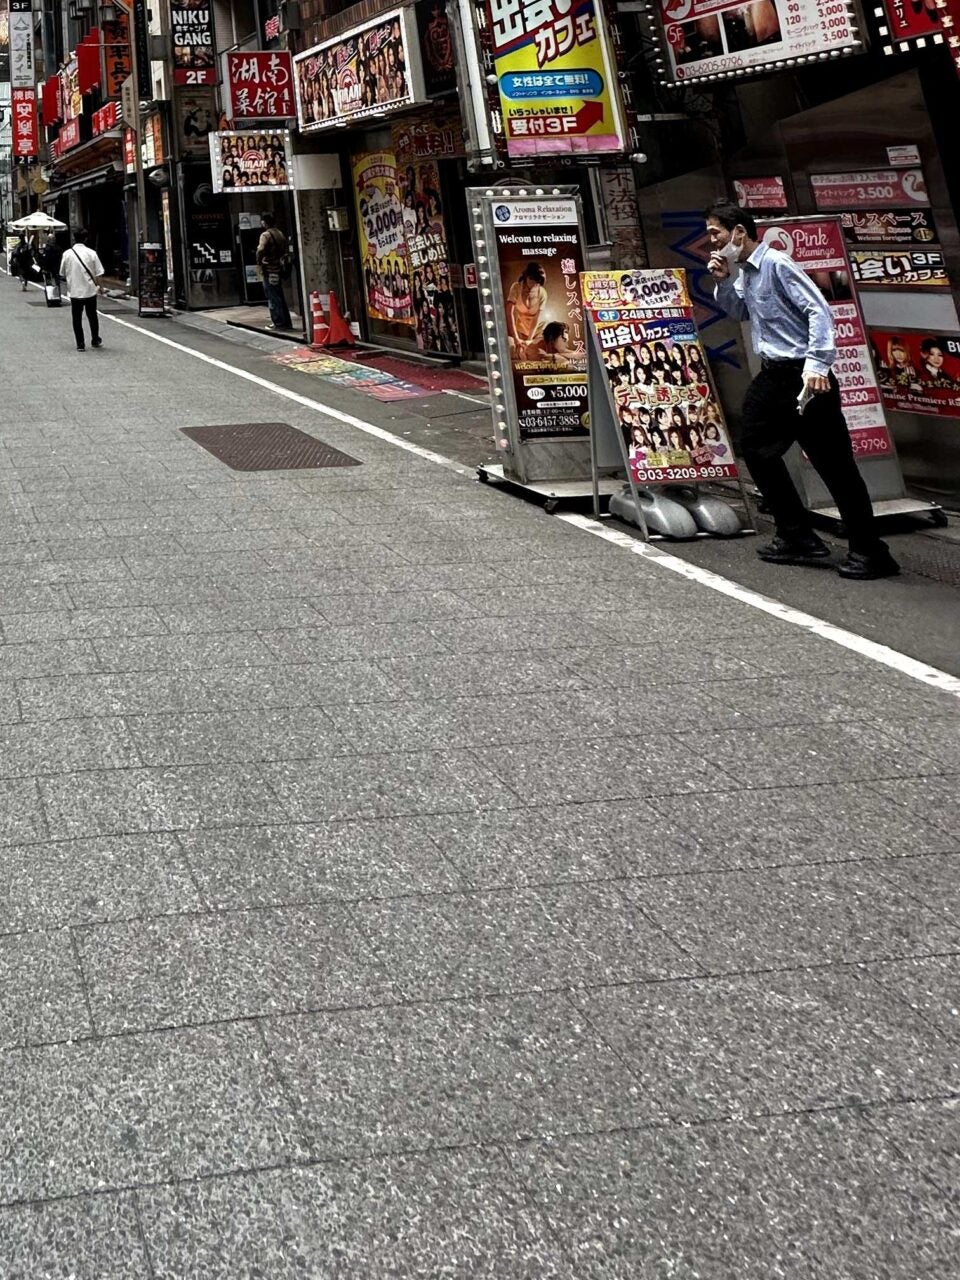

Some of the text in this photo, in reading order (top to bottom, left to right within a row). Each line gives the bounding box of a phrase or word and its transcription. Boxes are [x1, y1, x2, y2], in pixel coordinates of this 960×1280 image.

[12, 2, 29, 10] 3F
[818, 4, 844, 19] 3,000
[172, 10, 210, 26] NIKU
[820, 17, 847, 31] 3,000
[173, 32, 212, 47] GANG
[534, 11, 596, 69] カフェ
[668, 26, 683, 43] 5F
[823, 29, 850, 43] 3,500
[231, 54, 289, 86] 湖南
[185, 70, 207, 85] 2F
[13, 90, 35, 101] 焼肉
[234, 87, 278, 117] 菜館
[511, 116, 578, 135] 受付3F
[19, 156, 34, 165] 2F
[513, 206, 536, 214] Aroma
[499, 233, 578, 244] Welcom to relaxing
[791, 227, 830, 248] Pink
[521, 247, 557, 257] massage
[795, 247, 836, 259] Flamingo
[912, 253, 941, 265] 3F
[601, 310, 616, 320] 3F
